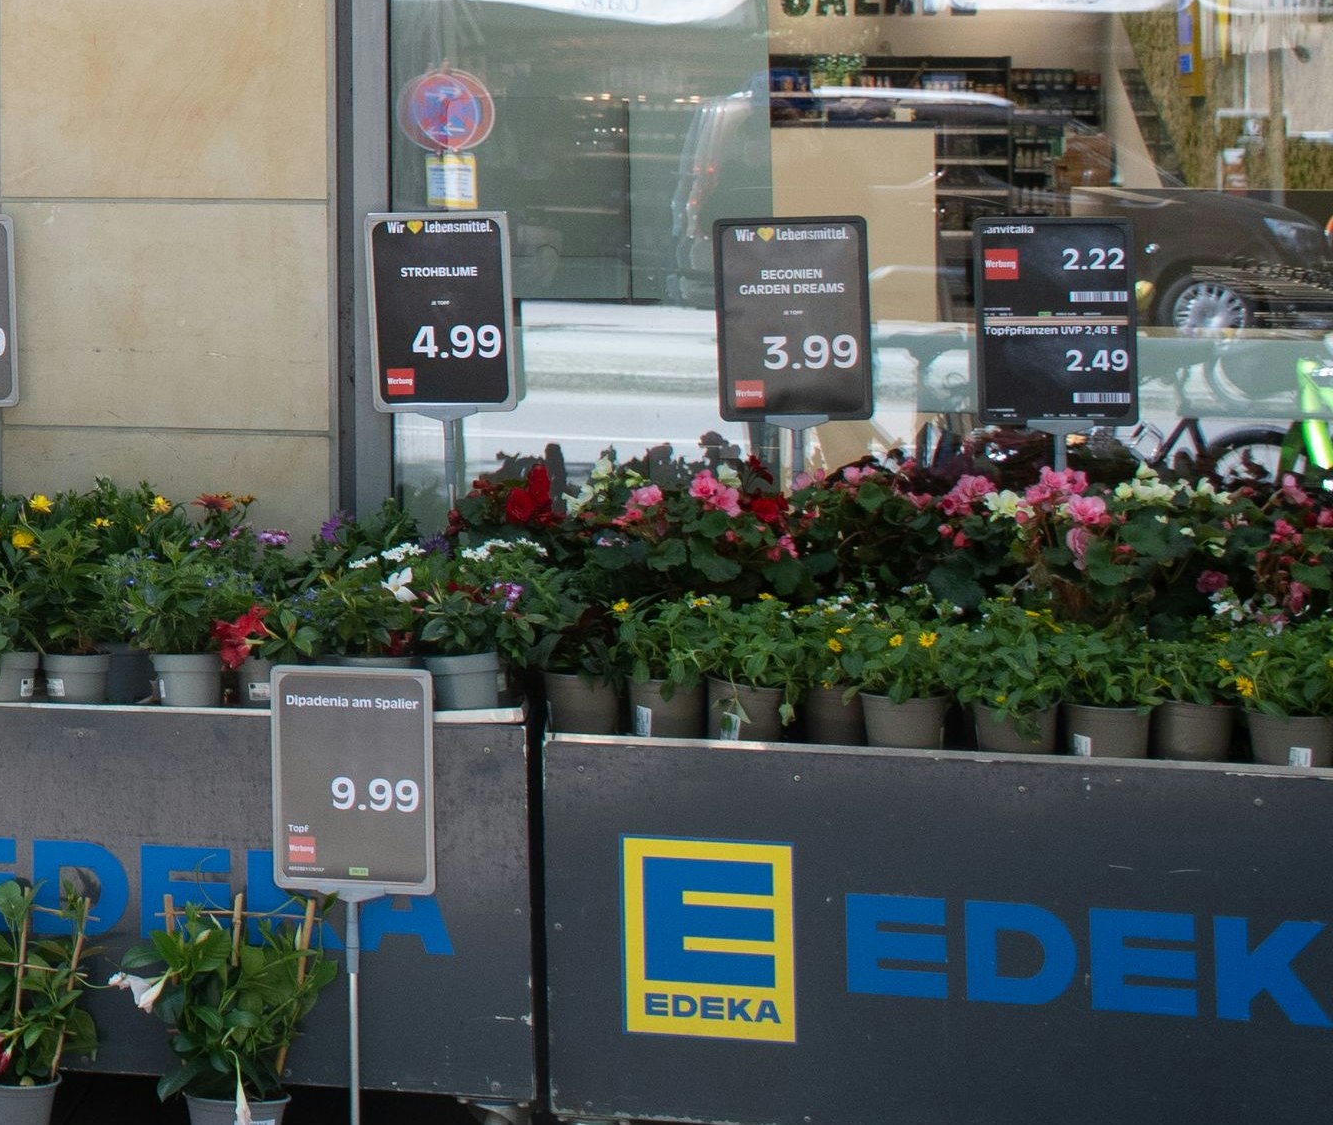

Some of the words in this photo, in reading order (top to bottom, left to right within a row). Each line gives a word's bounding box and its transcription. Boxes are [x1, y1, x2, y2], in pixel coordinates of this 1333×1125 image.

[387, 221, 405, 234] Wir
[424, 220, 493, 233] Lebensmittel.
[983, 225, 1035, 234] anvitalia
[735, 228, 755, 242] Wir
[776, 227, 849, 241] Lebensmittel.
[985, 260, 1016, 269] Werbung
[1062, 247, 1125, 271] 2.22
[401, 266, 478, 278] STROHBLUME
[761, 269, 823, 280] BEGONIEN
[739, 284, 790, 295] GARDEN
[793, 282, 845, 294] DREAMS
[984, 326, 1059, 337] Topfpflanzen
[1061, 325, 1083, 335] UVP
[1085, 325, 1108, 336] 2,49
[1111, 325, 1118, 335] E
[412, 324, 501, 359] 4.99
[762, 334, 859, 370] 3.99
[1065, 349, 1129, 372] 2.49
[387, 377, 413, 386] Werbung
[735, 390, 763, 398] Werbung
[286, 694, 349, 708] Dipadenia
[351, 698, 372, 708] am
[375, 697, 420, 711] Spalier
[331, 776, 420, 813] 9.99
[288, 824, 310, 833] Topf
[289, 844, 315, 854] Werbung
[644, 855, 776, 988] E
[644, 992, 782, 1025] EDEKA
